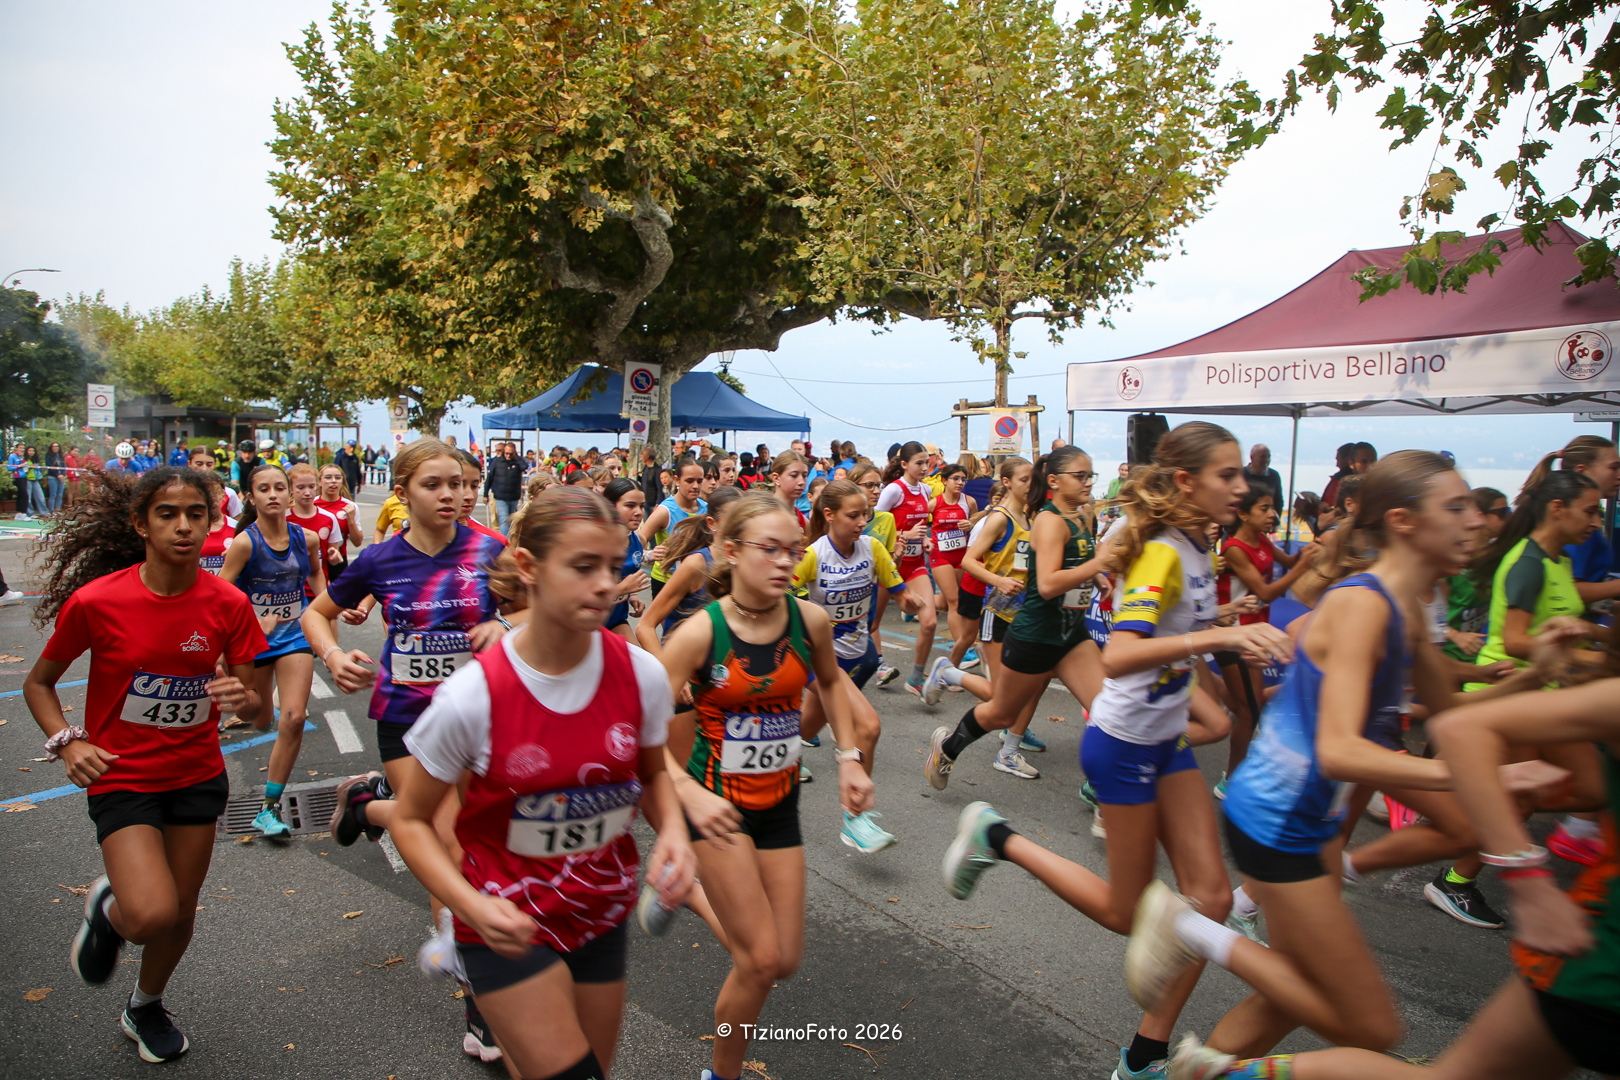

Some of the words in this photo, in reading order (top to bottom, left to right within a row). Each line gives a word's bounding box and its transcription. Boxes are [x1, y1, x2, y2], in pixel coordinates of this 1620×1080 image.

[1206, 359, 1336, 389] Polisportiva
[1346, 351, 1446, 378] Bellano
[944, 539, 961, 549] 305
[411, 597, 480, 610] SIDASTICO
[835, 602, 863, 619] 516
[409, 657, 455, 678] 585
[142, 703, 198, 724] 433
[741, 743, 788, 769] 269
[537, 815, 606, 854] 181
